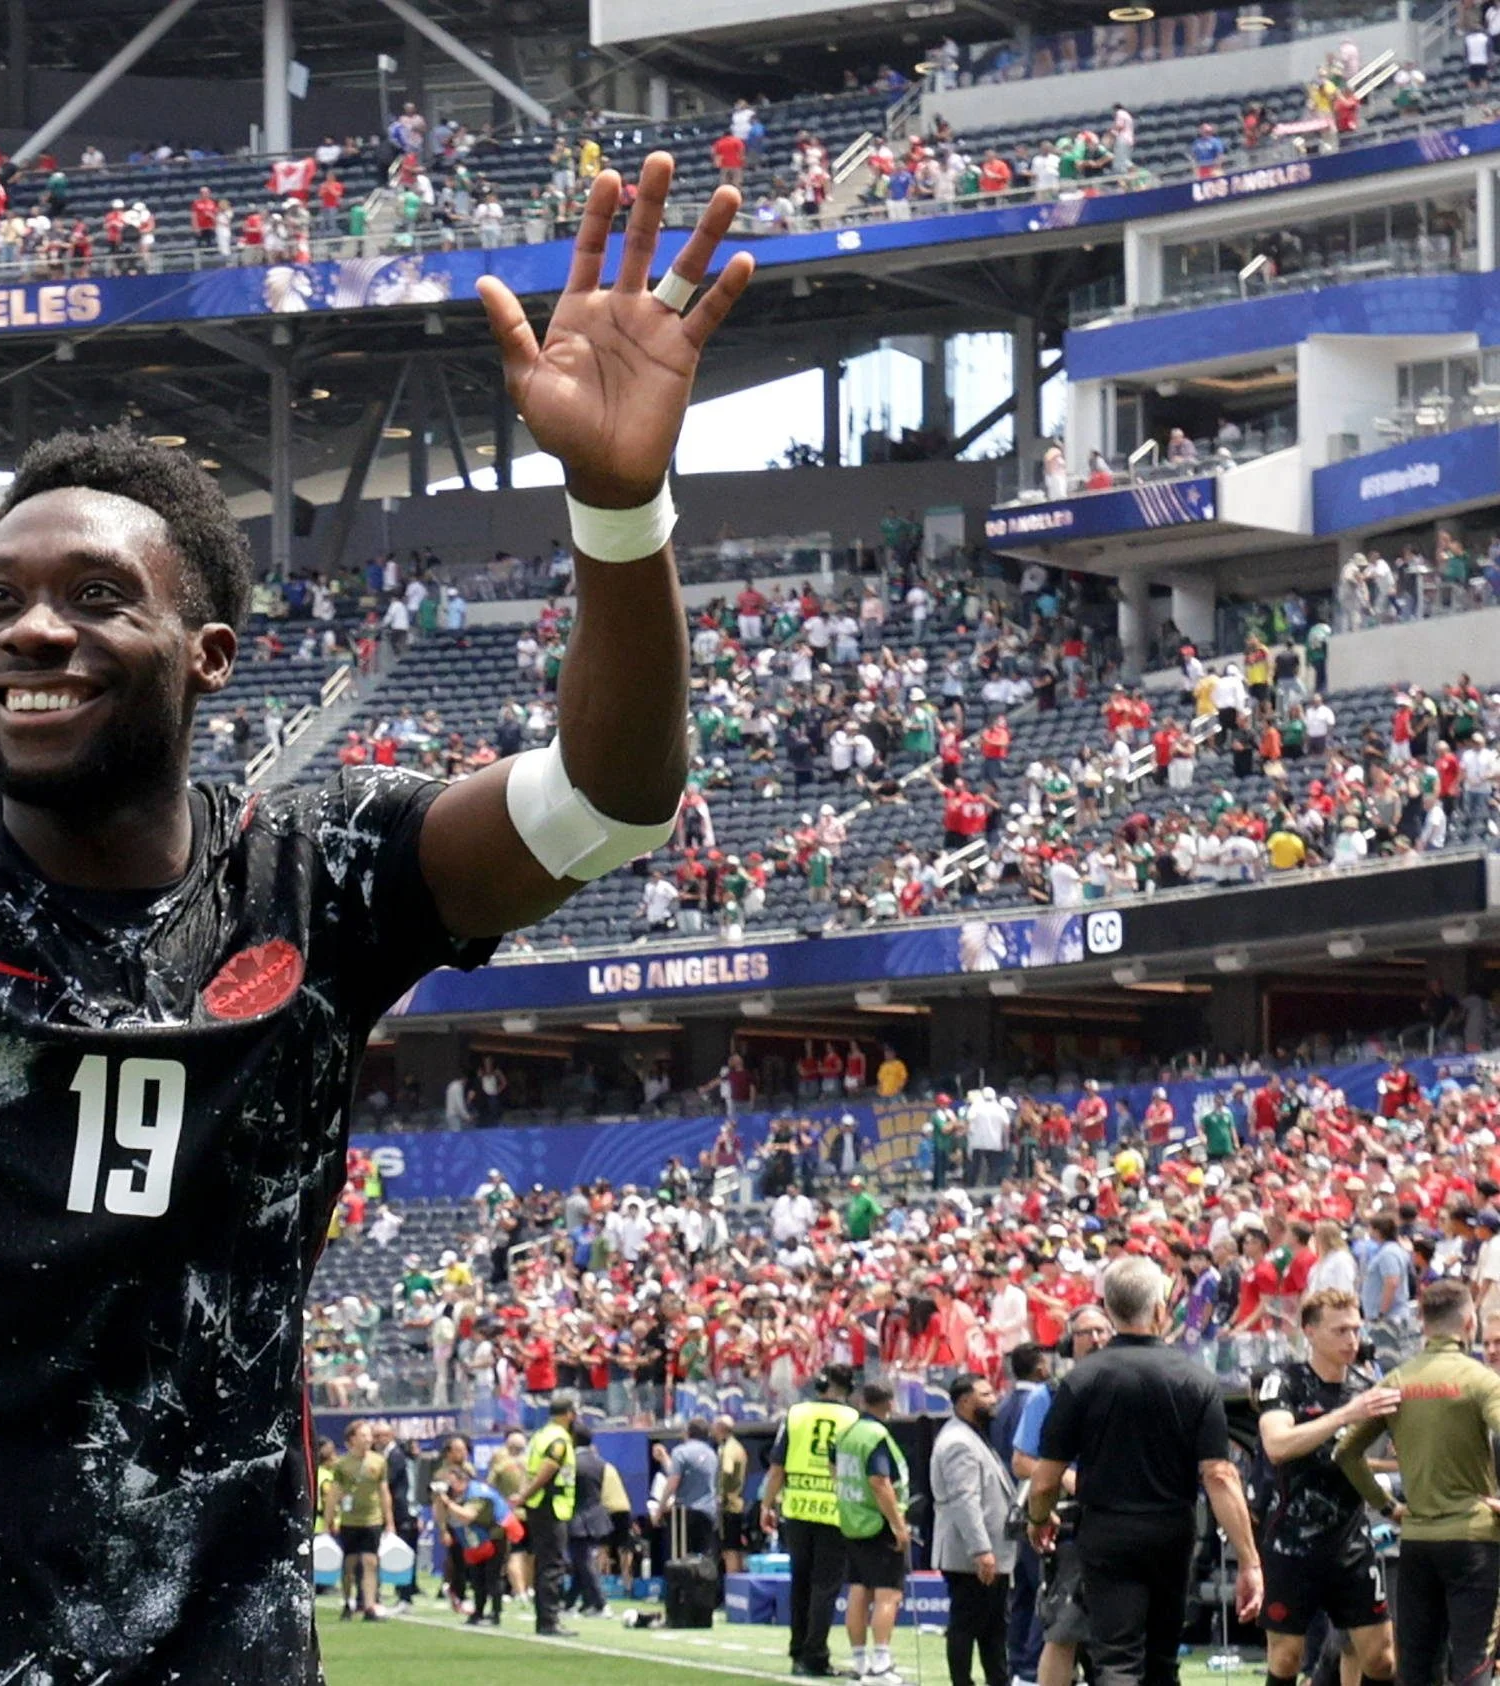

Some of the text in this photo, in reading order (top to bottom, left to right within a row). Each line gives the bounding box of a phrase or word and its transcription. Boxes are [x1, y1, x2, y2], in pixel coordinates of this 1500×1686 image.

[1093, 920, 1117, 946] CC
[213, 953, 294, 1009] CANADA
[588, 952, 770, 994] LOS ANGELES
[66, 1054, 187, 1218] 19
